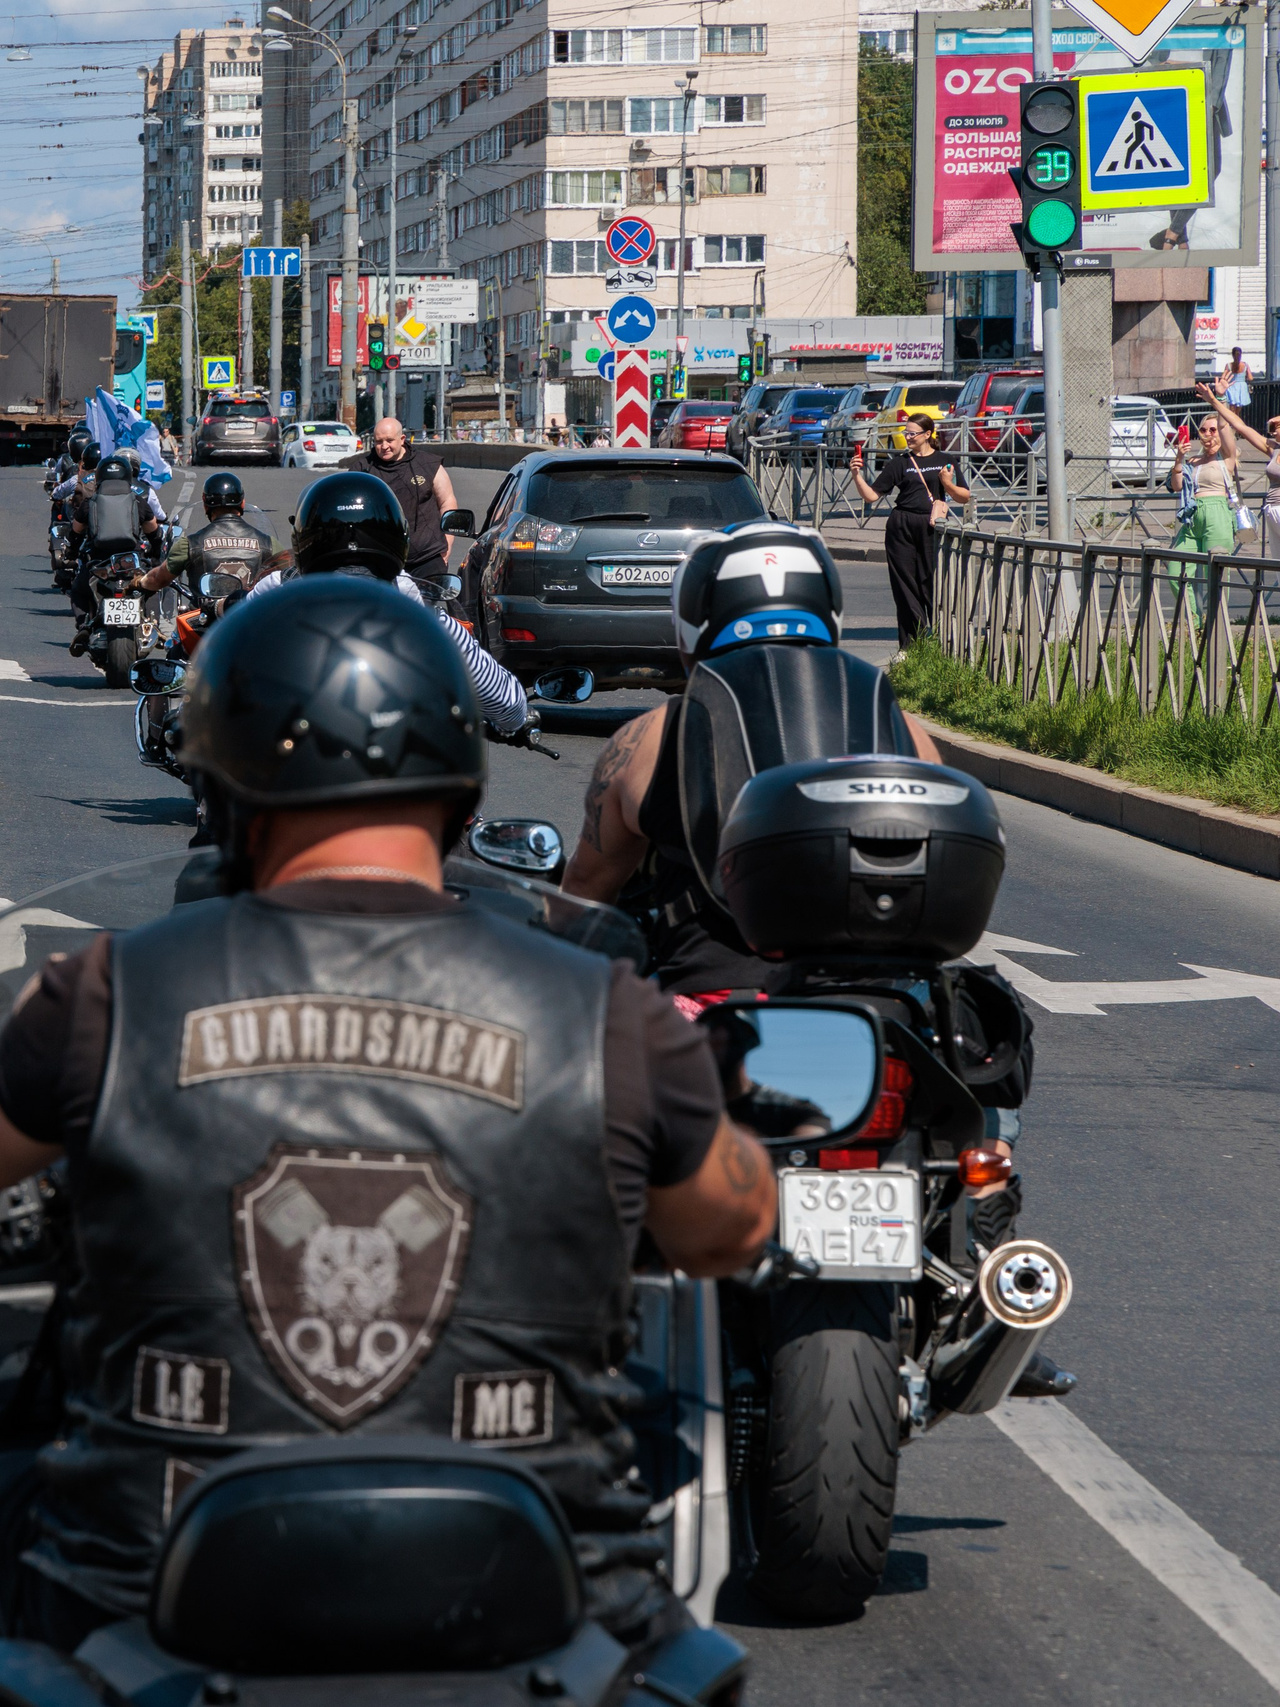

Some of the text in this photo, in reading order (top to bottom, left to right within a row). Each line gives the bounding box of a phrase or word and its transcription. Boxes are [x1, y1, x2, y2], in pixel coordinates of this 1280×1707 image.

[944, 67, 1033, 95] OZO
[949, 117, 1003, 127] ДО 30 ИЮЛЯ
[1036, 151, 1070, 183] 39
[371, 341, 383, 353] 40
[400, 348, 431, 358] СТОП
[707, 349, 736, 359] YOTA
[205, 538, 257, 549] GUARDSMEN
[615, 568, 642, 581] 602
[109, 601, 135, 611] 9250
[125, 614, 138, 623] 47
[849, 783, 927, 796] SHAD
[199, 1003, 510, 1088] GUARDSMEN
[799, 1178, 899, 1213] 3620
[849, 1215, 879, 1228] RUS
[861, 1229, 910, 1264] 47
[473, 1380, 536, 1440] MC
